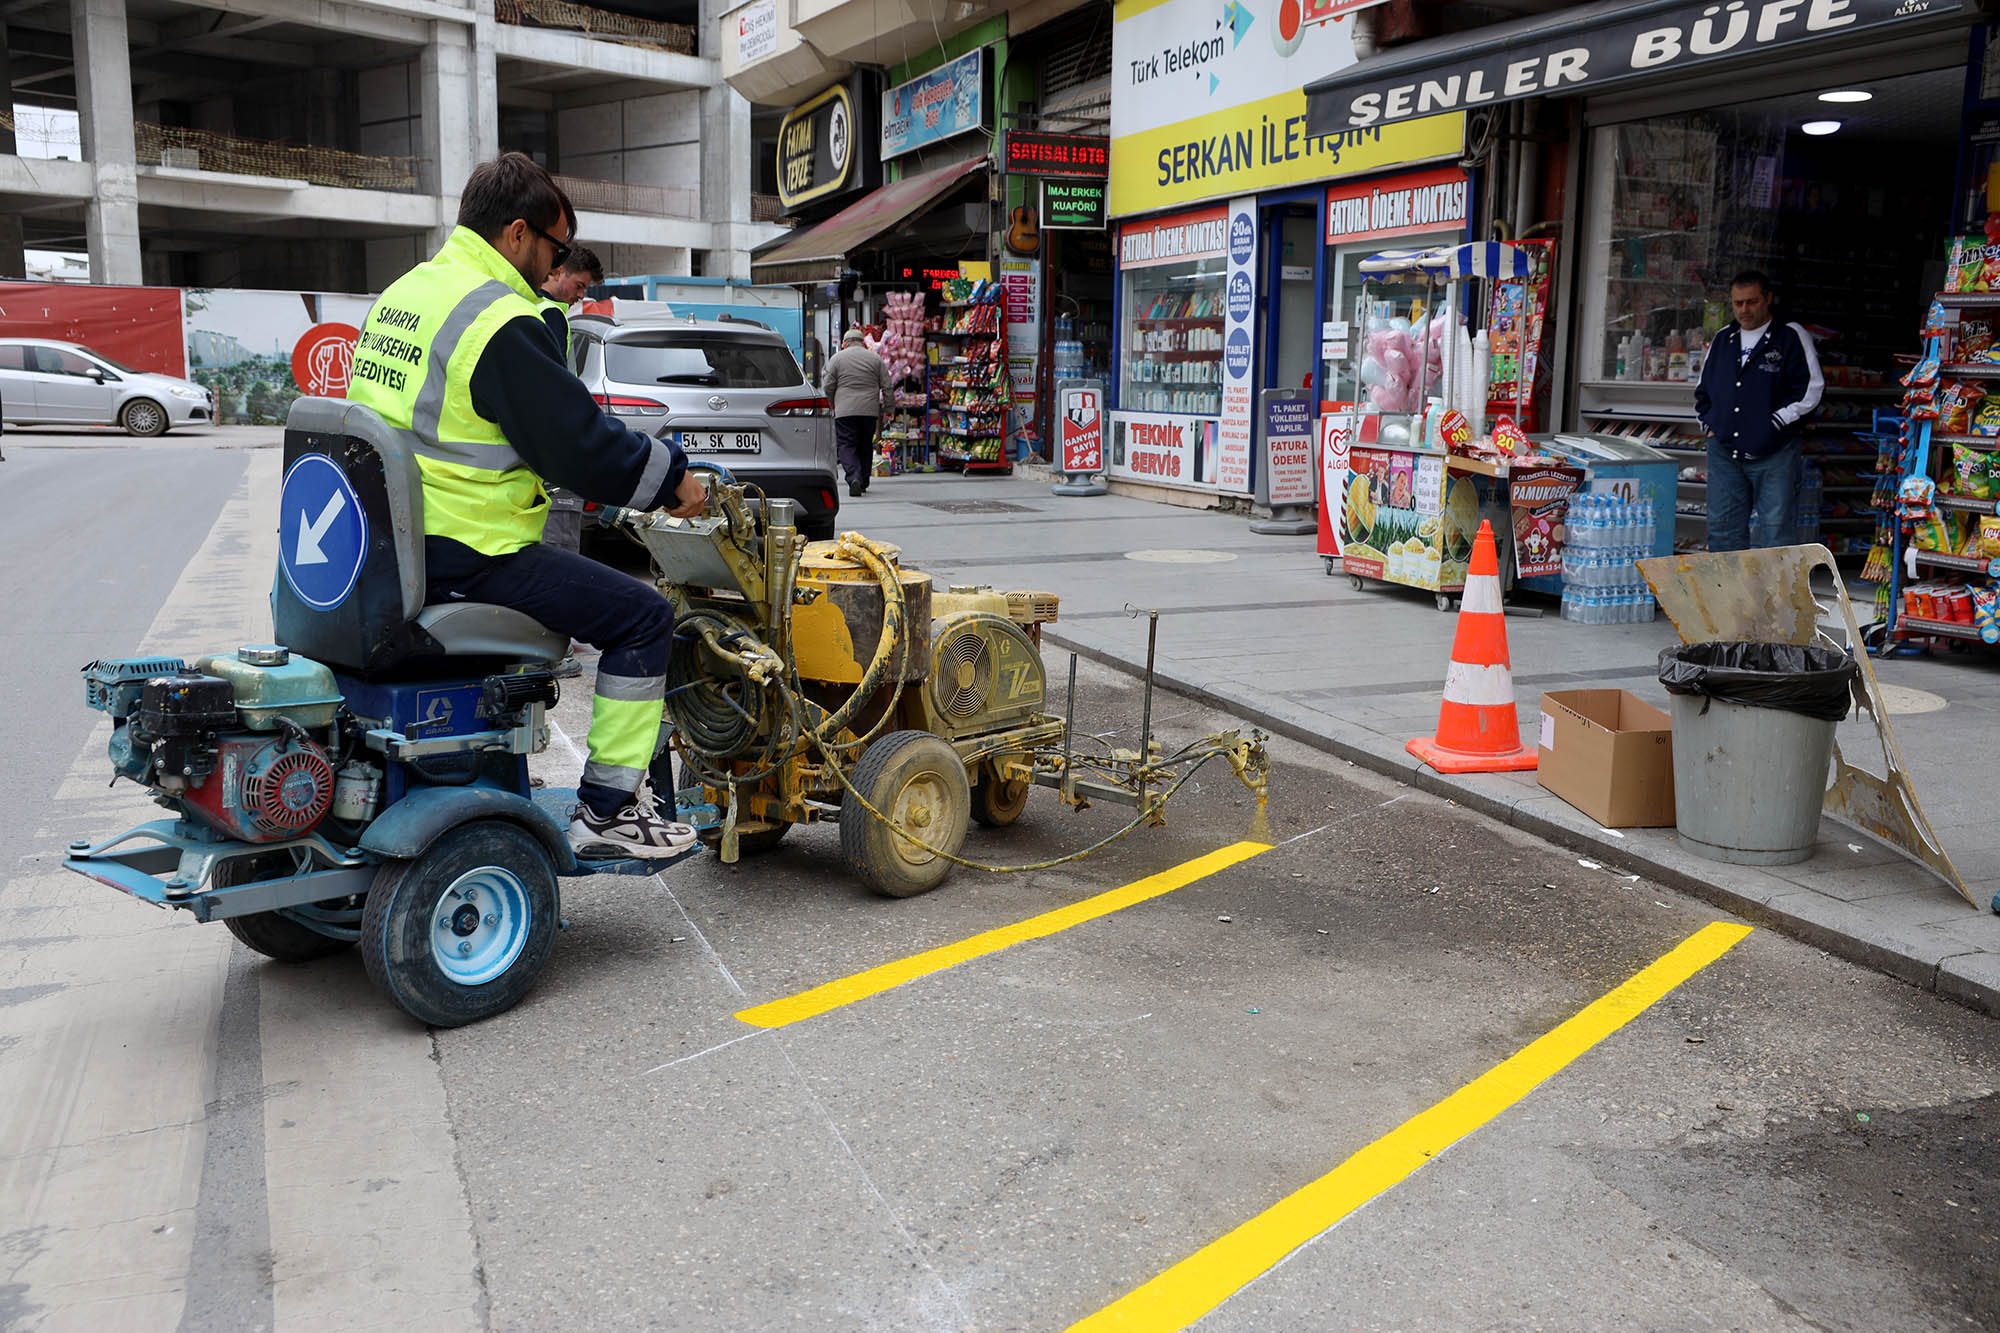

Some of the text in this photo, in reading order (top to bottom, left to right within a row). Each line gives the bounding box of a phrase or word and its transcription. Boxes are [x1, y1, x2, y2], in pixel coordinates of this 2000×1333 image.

[1894, 2, 1930, 17] ALTAY
[1131, 35, 1224, 86] Türk Telekom
[1349, 0, 1858, 127] ŞENLER BÜFE
[786, 116, 812, 159] FATMA
[1011, 142, 1105, 165] SAYISAL LOTO
[1157, 128, 1253, 187] SERKAN
[786, 153, 811, 192] TEYZE
[1047, 184, 1102, 198] İMAJ ERKEK
[1052, 200, 1097, 212] KUAFÖRÜ
[1329, 180, 1467, 236] FATURA ÖDEME NOKTASI
[1122, 218, 1227, 264] FATURA ÖDEME NOKTASI
[376, 306, 421, 332] SAKARYA
[360, 331, 423, 366] BÜYÜKŞEHİR
[1283, 404, 1305, 413] PAKET
[1270, 413, 1309, 423] YÜKLEMESİ
[683, 434, 758, 448] 54 SK 804
[1065, 429, 1099, 447] GANYAN
[1130, 420, 1183, 448] TEKNİK
[1496, 433, 1515, 450] 20
[1271, 440, 1308, 451] FATURA
[1131, 450, 1181, 478] SERVİS
[1273, 454, 1307, 466] ÖDEME
[1328, 459, 1349, 470] ALGID
[1512, 485, 1572, 501] PAMUKDEDE
[425, 726, 454, 735] GRACO
